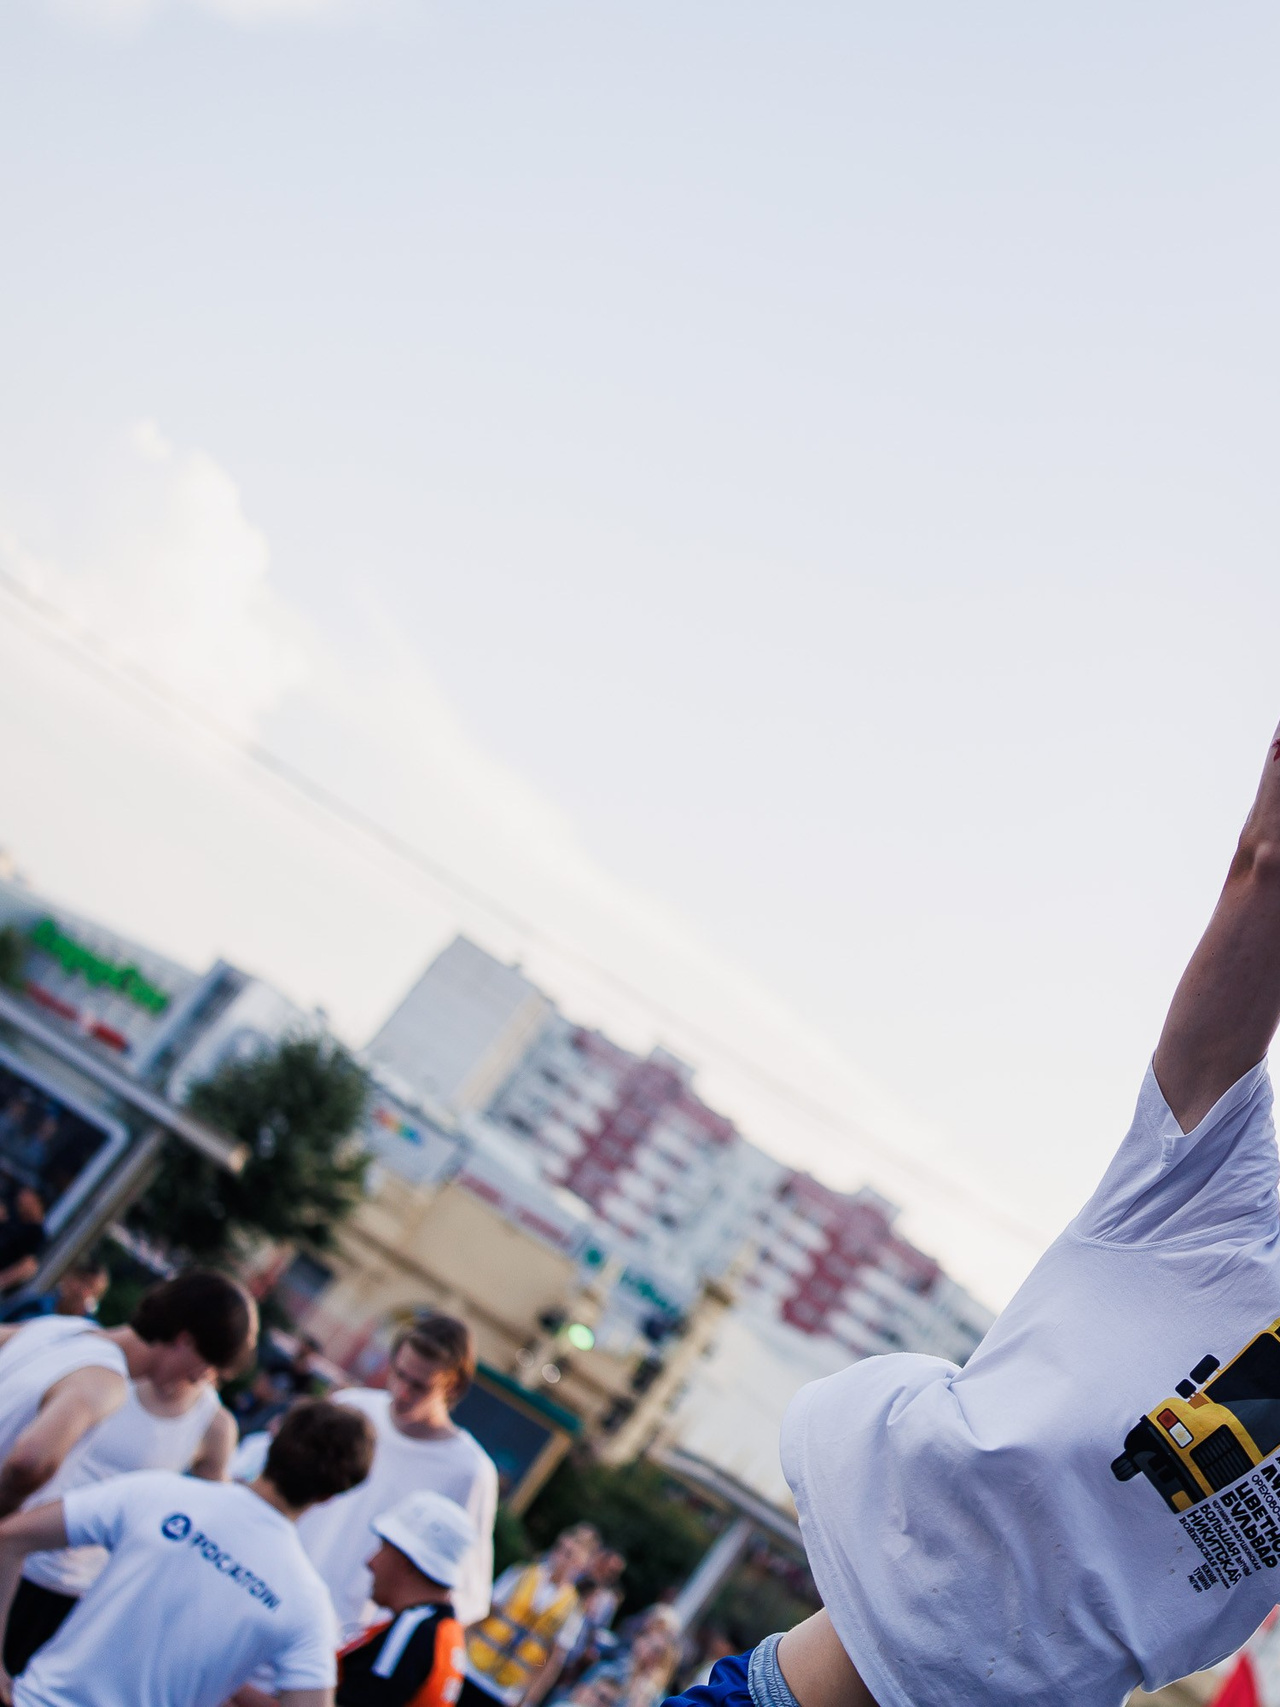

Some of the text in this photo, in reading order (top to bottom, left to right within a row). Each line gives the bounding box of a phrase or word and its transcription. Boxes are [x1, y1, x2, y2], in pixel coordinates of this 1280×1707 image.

[1178, 1516, 1219, 1568] ВОЙКОВСКАЯ
[1186, 1509, 1243, 1586] НИКИТСКАЯ
[1198, 1503, 1242, 1557] БОЛЬШАЯ
[1211, 1499, 1262, 1572] ЧЕРТАНОВО БАБУШКИНСКАЯ
[1219, 1490, 1279, 1569] БУЛЬВАР
[1192, 1566, 1212, 1591] ТУШИНО
[1200, 1562, 1219, 1585] ЮЖНОЕ
